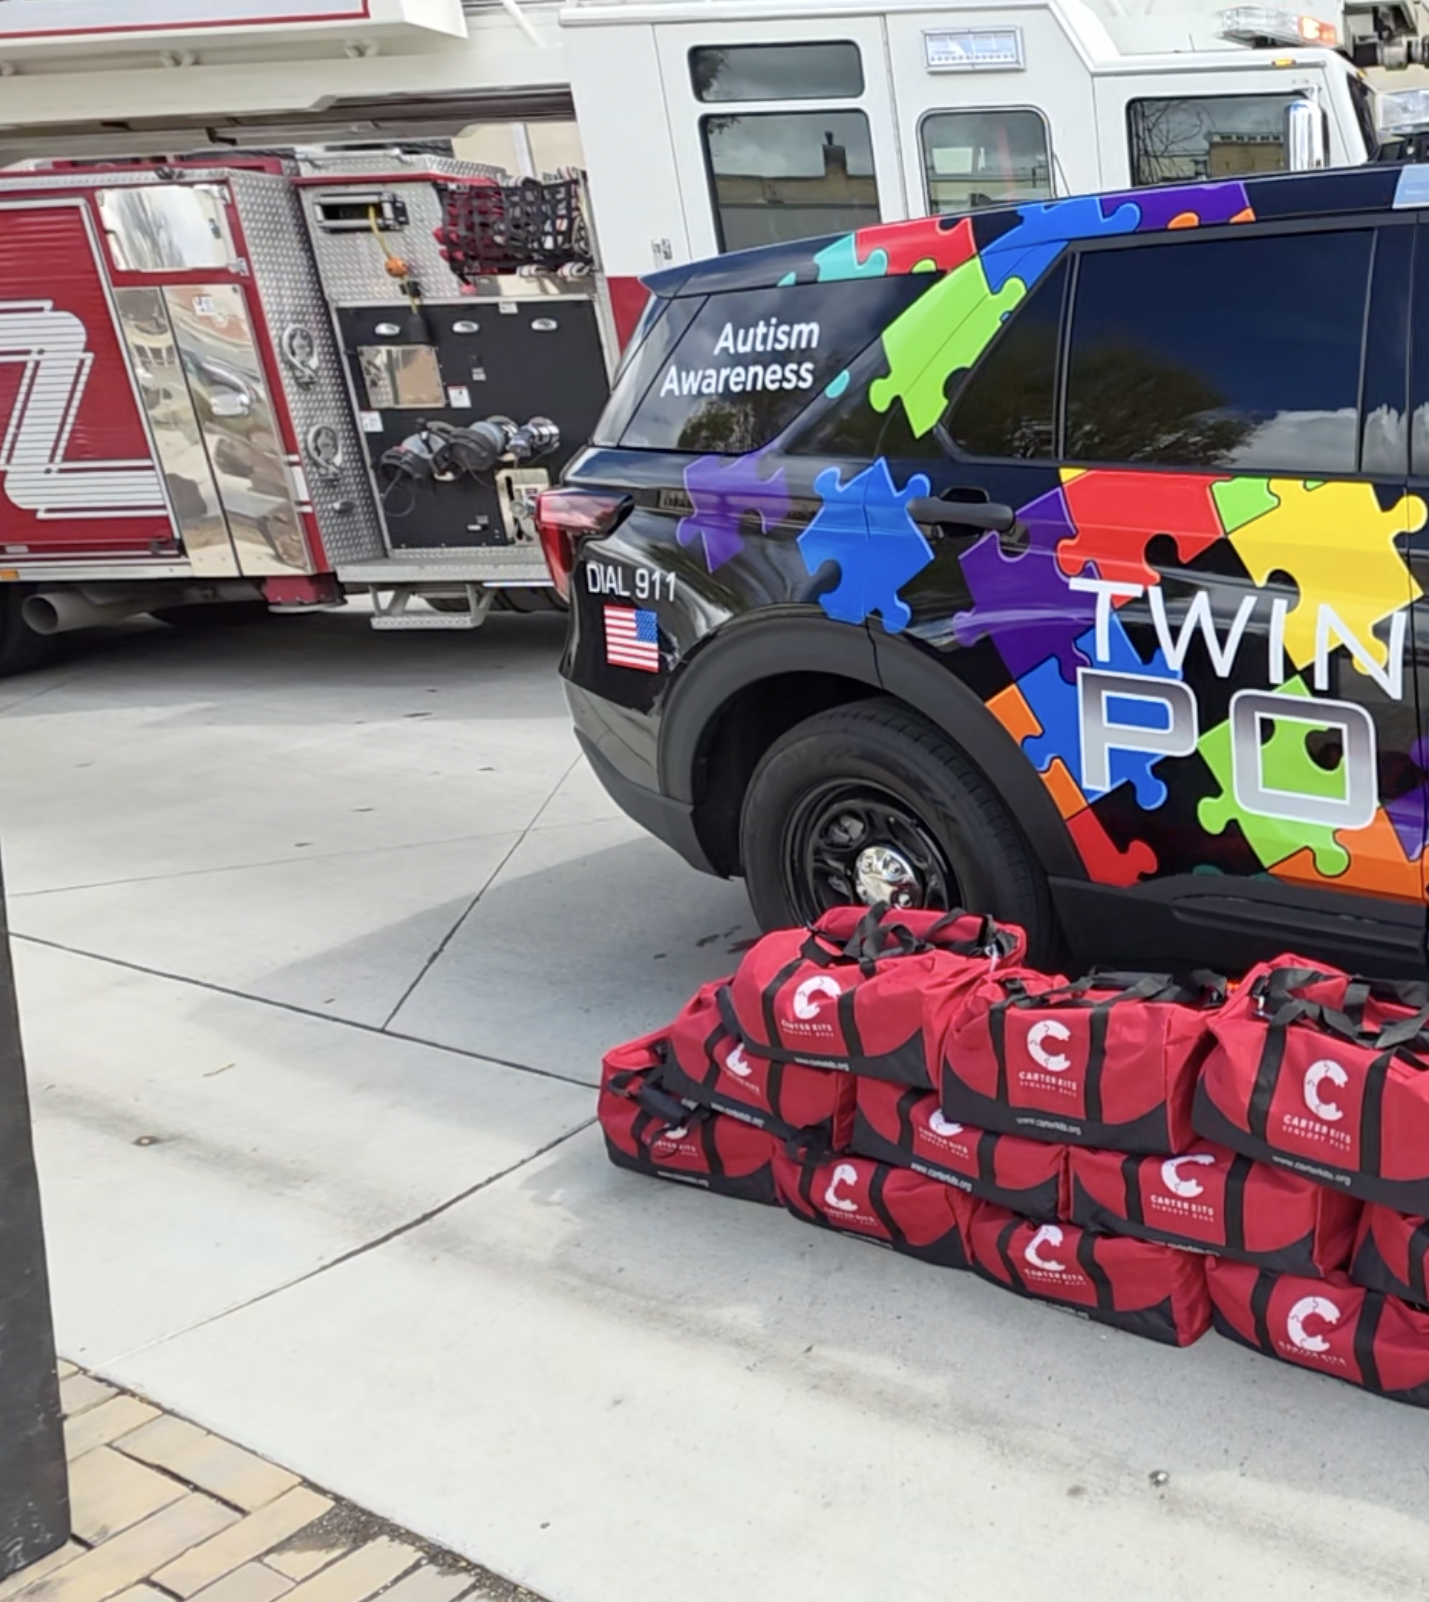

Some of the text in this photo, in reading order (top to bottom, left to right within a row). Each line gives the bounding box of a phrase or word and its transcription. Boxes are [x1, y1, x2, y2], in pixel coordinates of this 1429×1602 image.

[713, 317, 820, 356] Autism
[659, 361, 815, 397] Awareness
[586, 560, 676, 602] DIAL 911
[1068, 577, 1407, 700] TWIN
[1282, 1114, 1328, 1134] CARTER
